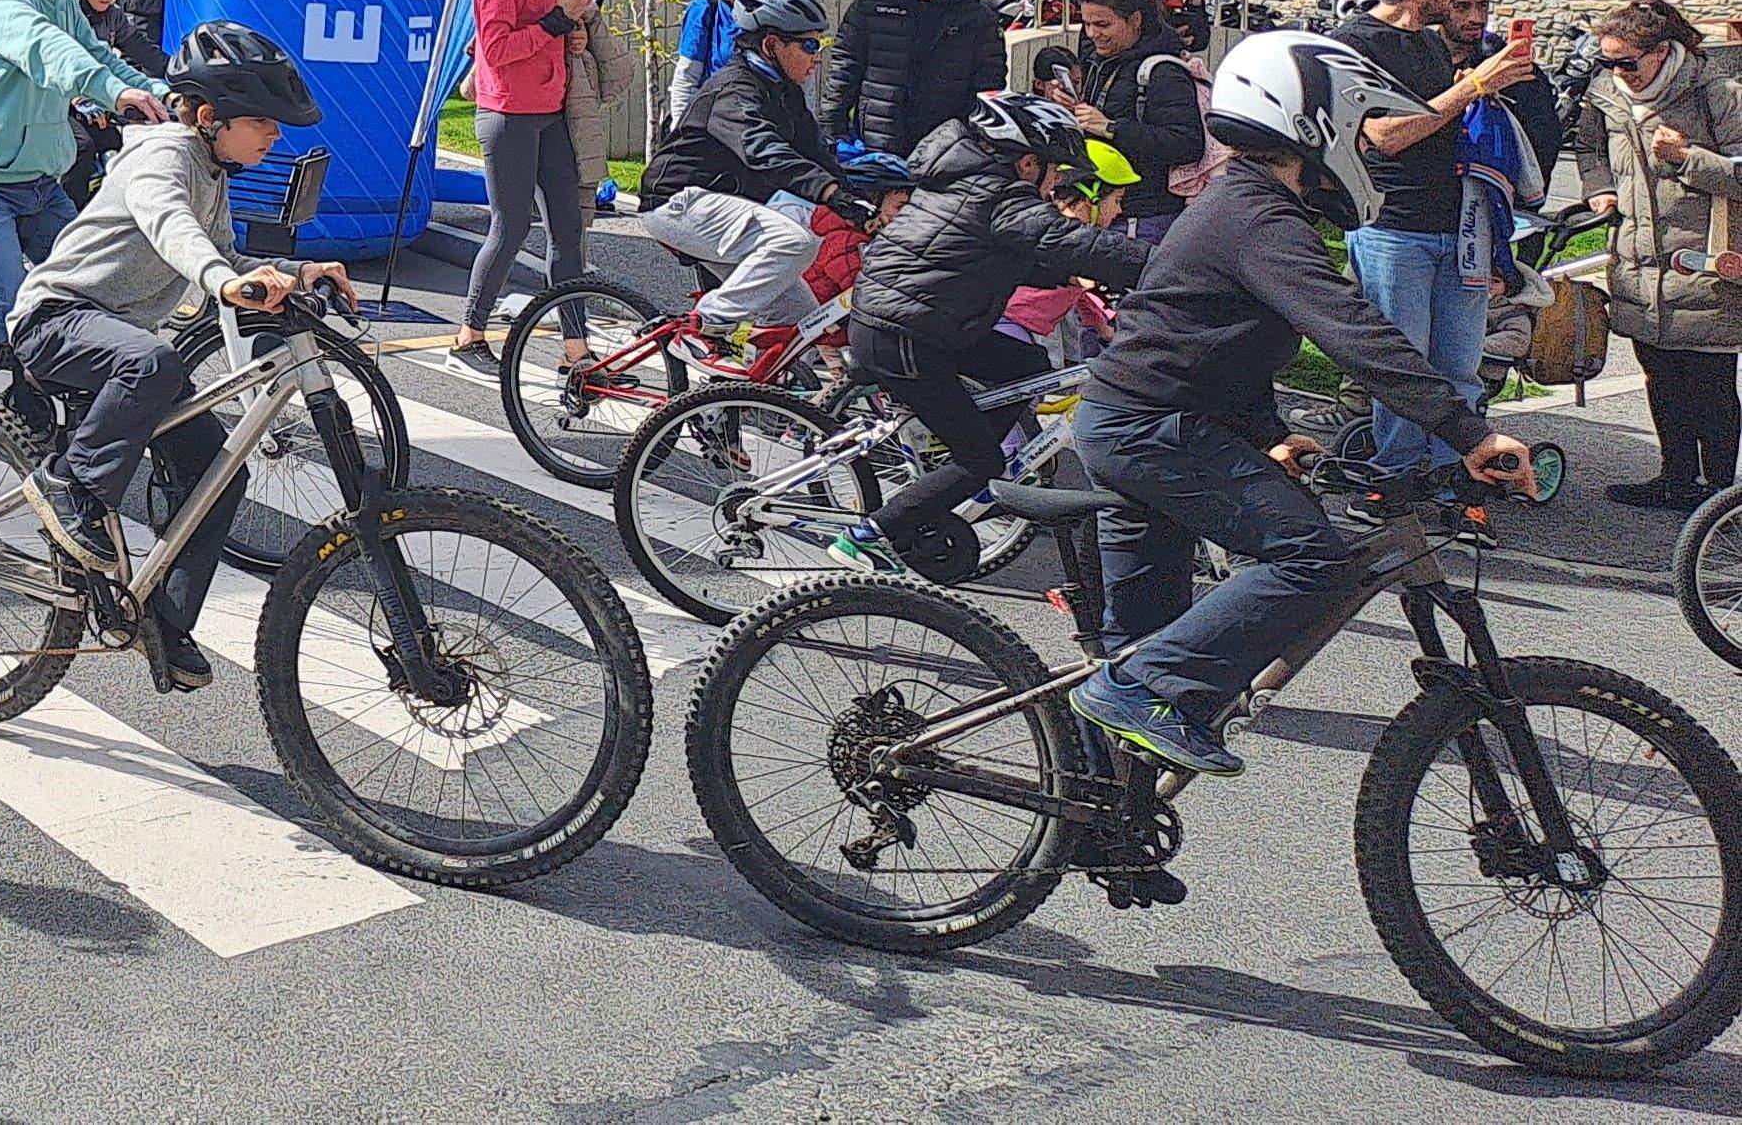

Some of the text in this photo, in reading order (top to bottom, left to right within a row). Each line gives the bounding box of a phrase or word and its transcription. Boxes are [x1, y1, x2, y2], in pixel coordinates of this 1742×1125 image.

[407, 16, 433, 63] El
[1296, 118, 1316, 143] BELL
[1462, 241, 1477, 270] Team
[318, 507, 406, 561] MAIS
[755, 595, 833, 639] MAXXIS
[1577, 685, 1674, 728] MAXXIS
